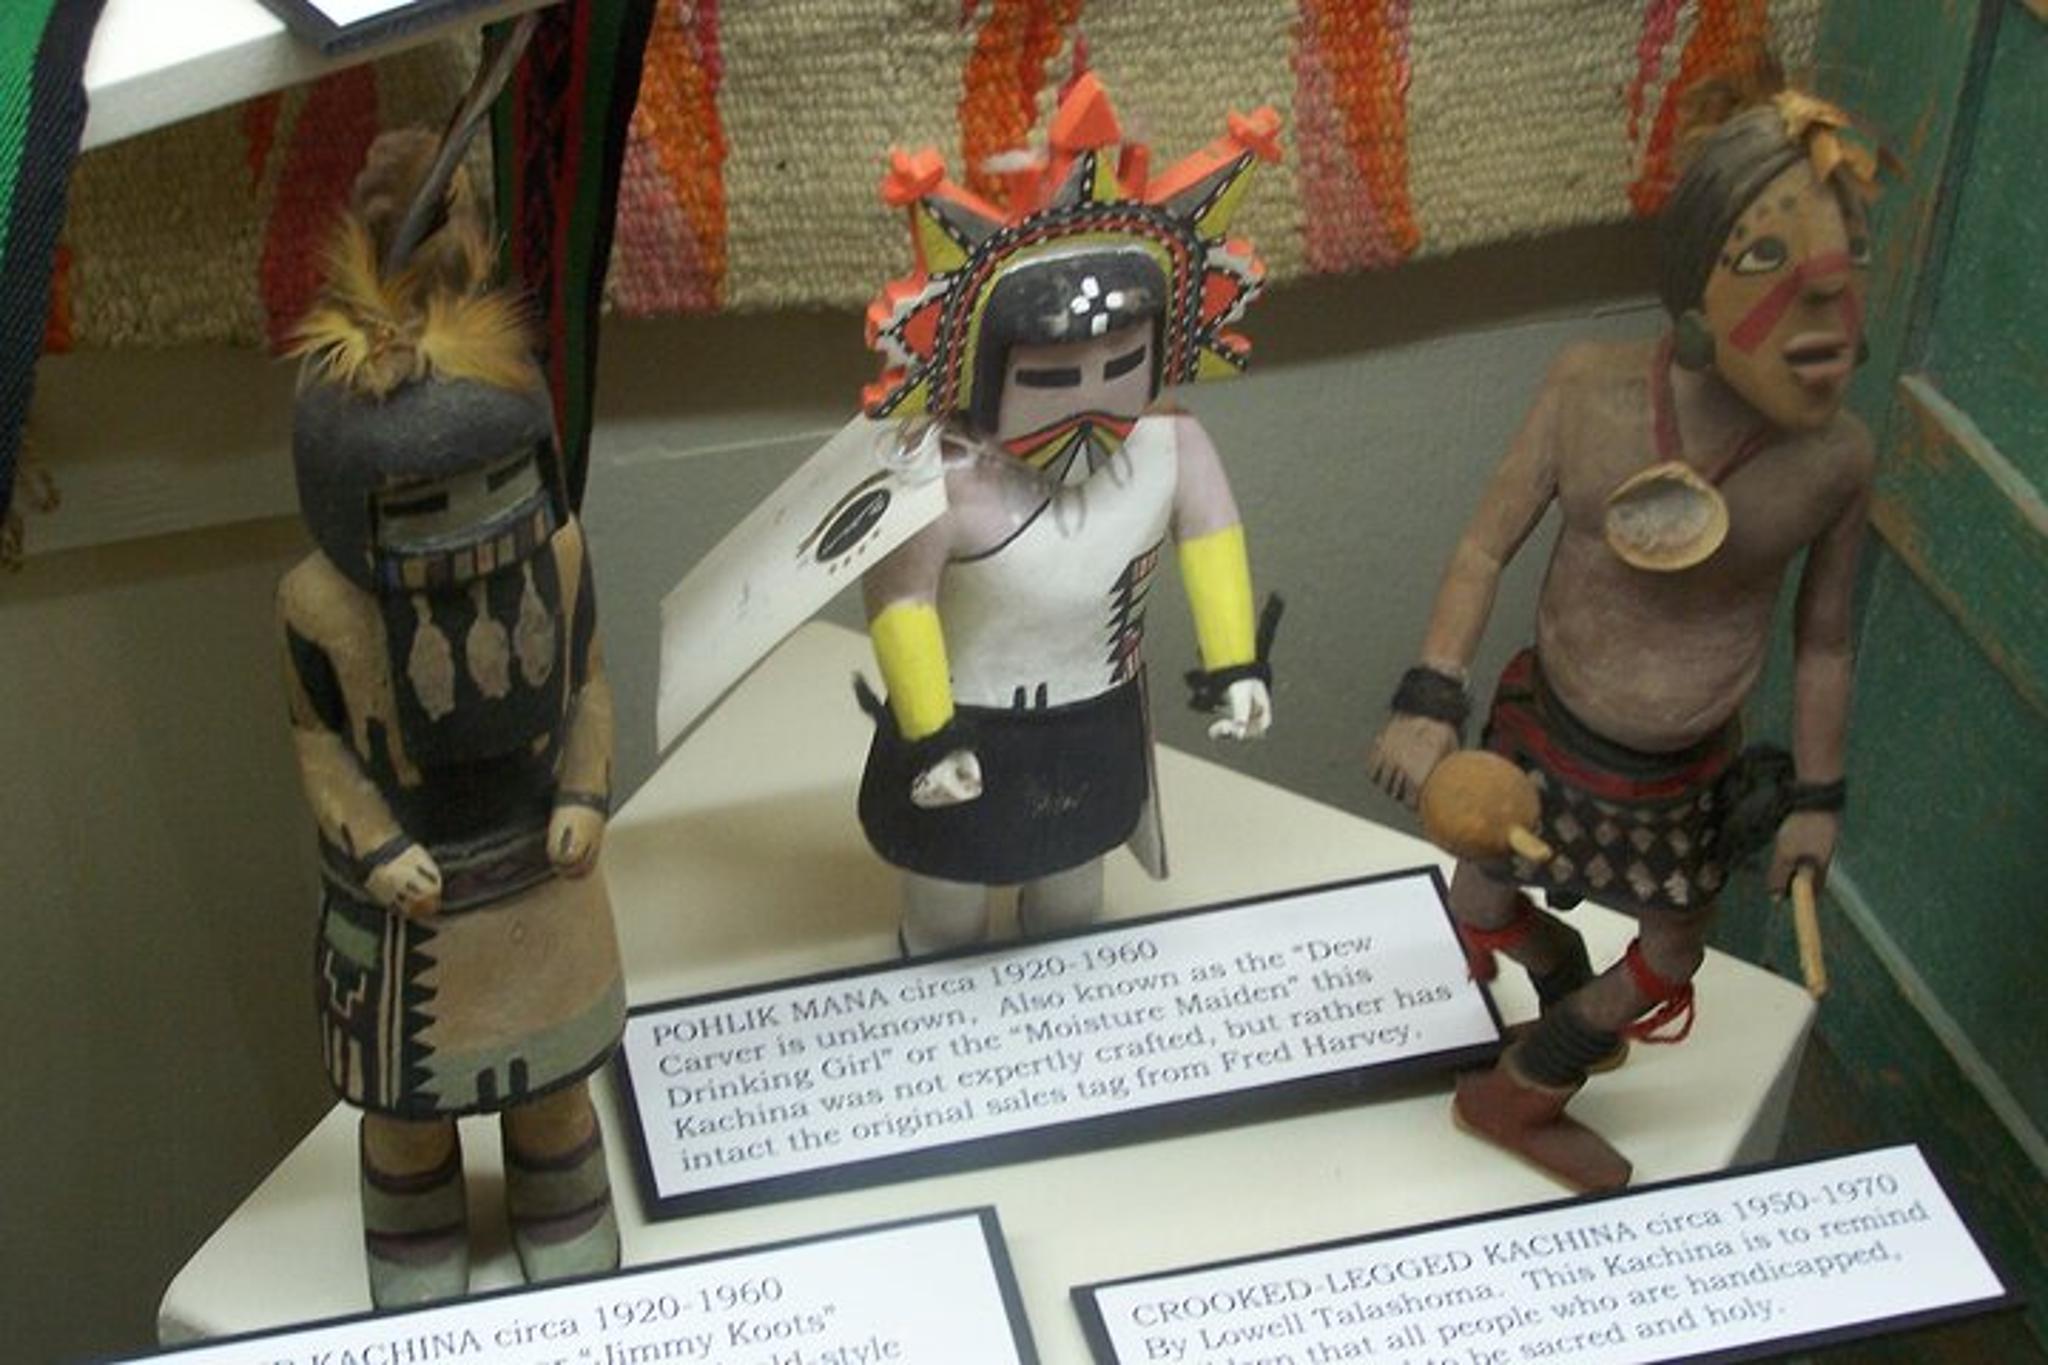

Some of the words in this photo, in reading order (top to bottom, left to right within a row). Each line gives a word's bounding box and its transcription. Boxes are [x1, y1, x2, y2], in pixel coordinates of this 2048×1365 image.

[652, 1004, 780, 1047] POHLIK
[791, 987, 889, 1023] MANA
[899, 975, 976, 1004] circa
[991, 939, 1158, 986] 1920-1960
[659, 1042, 764, 1078] Carver
[778, 1034, 806, 1058] is
[1001, 992, 1064, 1018] Also
[1074, 970, 1179, 1003] known
[1190, 963, 1226, 982] as
[1235, 949, 1286, 975] the
[667, 1065, 814, 1108] Drinking
[905, 1044, 939, 1065] or
[948, 1029, 1002, 1059] the
[1311, 966, 1374, 995] this
[673, 1100, 807, 1139] Kachina
[821, 1089, 883, 1113] was
[895, 1076, 945, 1099] not
[957, 1049, 1083, 1088] expertly
[1226, 1016, 1278, 1040] but
[1290, 996, 1385, 1026] rather
[1393, 983, 1453, 1008] has
[681, 1140, 776, 1171] intact
[788, 1122, 840, 1150] the
[852, 1101, 975, 1137] original
[986, 1088, 1067, 1115] sales
[1077, 1075, 1130, 1099] tag
[1137, 1060, 1209, 1088] from
[1221, 1040, 1292, 1073] Fred
[493, 1319, 578, 1348] circa
[597, 1276, 783, 1332] 1920-1960
[1131, 1250, 1472, 1329] CROOKED-LEGGED
[1484, 1221, 1638, 1266] KACHINA
[1646, 1200, 1723, 1233] circa
[1732, 1172, 1899, 1222] 1950-1970
[1146, 1337, 1187, 1362] By
[1200, 1313, 1304, 1350] Lowell
[1521, 1262, 1596, 1291] This
[1603, 1239, 1734, 1279] Kachina
[1745, 1228, 1772, 1254] is
[1778, 1222, 1810, 1245] to
[1818, 1199, 1930, 1238] remind
[1307, 1337, 1373, 1363] that
[1386, 1324, 1426, 1350] all
[1438, 1306, 1542, 1346] people
[1551, 1294, 1619, 1320] who
[1627, 1280, 1681, 1304] are
[1467, 1348, 1509, 1365] be
[1519, 1322, 1626, 1360] sacred
[1634, 1309, 1699, 1337] and
